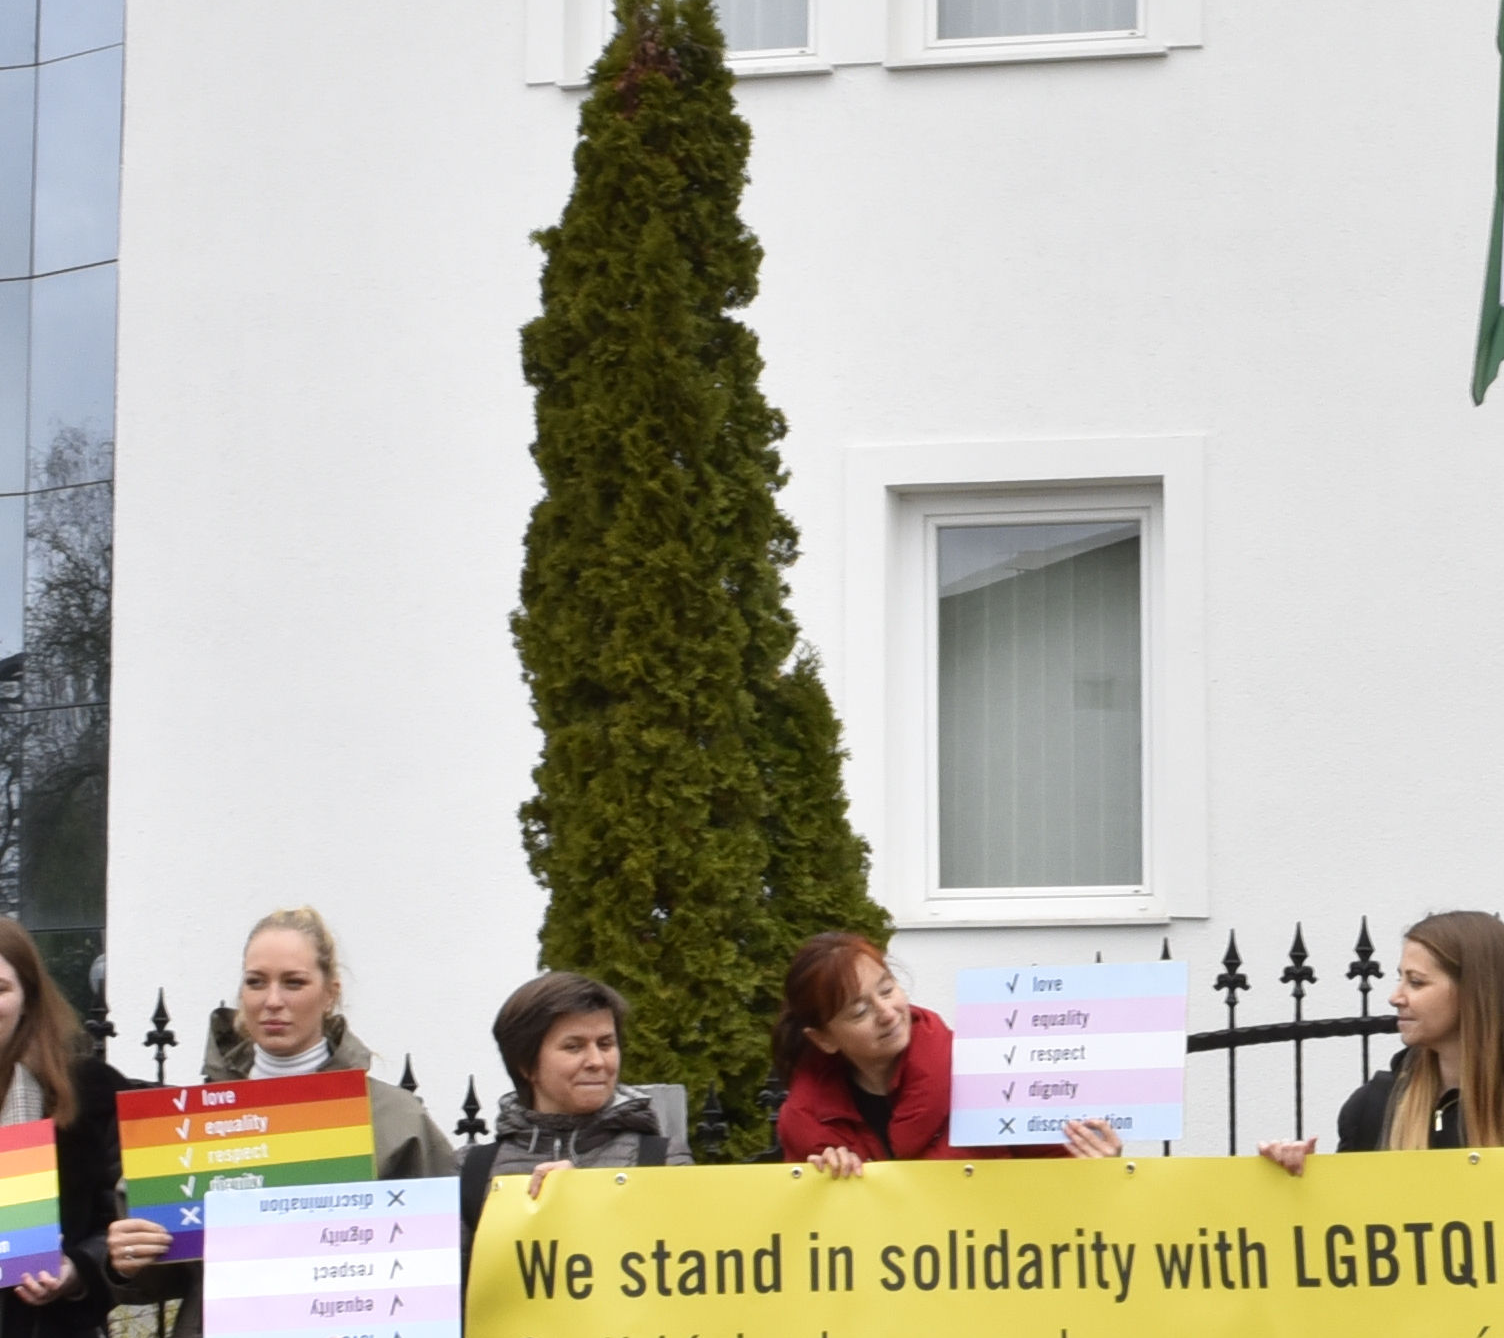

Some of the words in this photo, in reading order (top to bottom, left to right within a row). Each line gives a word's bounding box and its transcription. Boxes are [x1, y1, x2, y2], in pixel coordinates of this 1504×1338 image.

[1033, 976, 1064, 992] love
[1031, 1009, 1090, 1029] equality
[1029, 1045, 1086, 1063] respect
[202, 1089, 236, 1106] love
[1028, 1079, 1079, 1099] dignity
[205, 1115, 269, 1136] equality
[207, 1143, 269, 1165] respect
[259, 1193, 374, 1214] discrimination
[320, 1225, 374, 1246] dignity
[314, 1263, 374, 1281] respect
[516, 1240, 593, 1299] We
[621, 1234, 783, 1298] stand
[810, 1232, 854, 1293] in
[880, 1228, 1136, 1304] solidarity
[1156, 1227, 1268, 1290] with
[310, 1296, 374, 1317] equality
